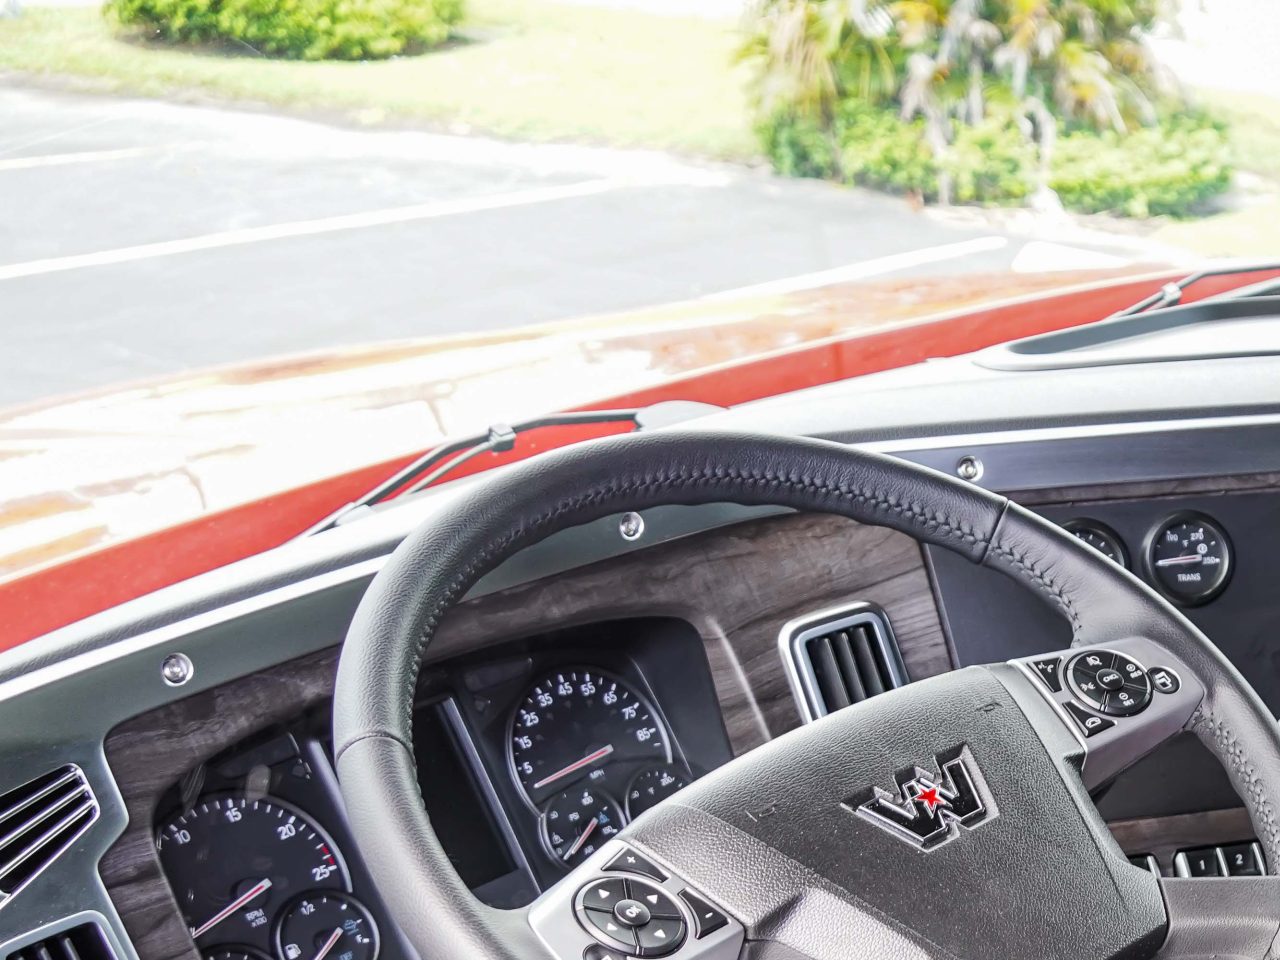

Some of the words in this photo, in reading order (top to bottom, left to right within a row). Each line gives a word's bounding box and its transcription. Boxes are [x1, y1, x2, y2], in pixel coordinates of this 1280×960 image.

[1177, 573, 1201, 582] TRANS
[558, 682, 573, 696] 45
[580, 682, 595, 696] 55
[536, 693, 553, 707] 35
[603, 690, 617, 705] 65
[523, 713, 539, 727] 25
[622, 706, 637, 720] 75
[518, 736, 532, 749] 15
[636, 729, 650, 742] 85
[524, 763, 533, 774] 5
[226, 808, 242, 823] 15
[175, 830, 191, 844] 10
[277, 823, 296, 840] 20
[1200, 860, 1205, 870] 1
[1236, 854, 1243, 864] 2
[312, 864, 329, 881] 25
[246, 909, 264, 921] RPM
[627, 904, 642, 918] OK
